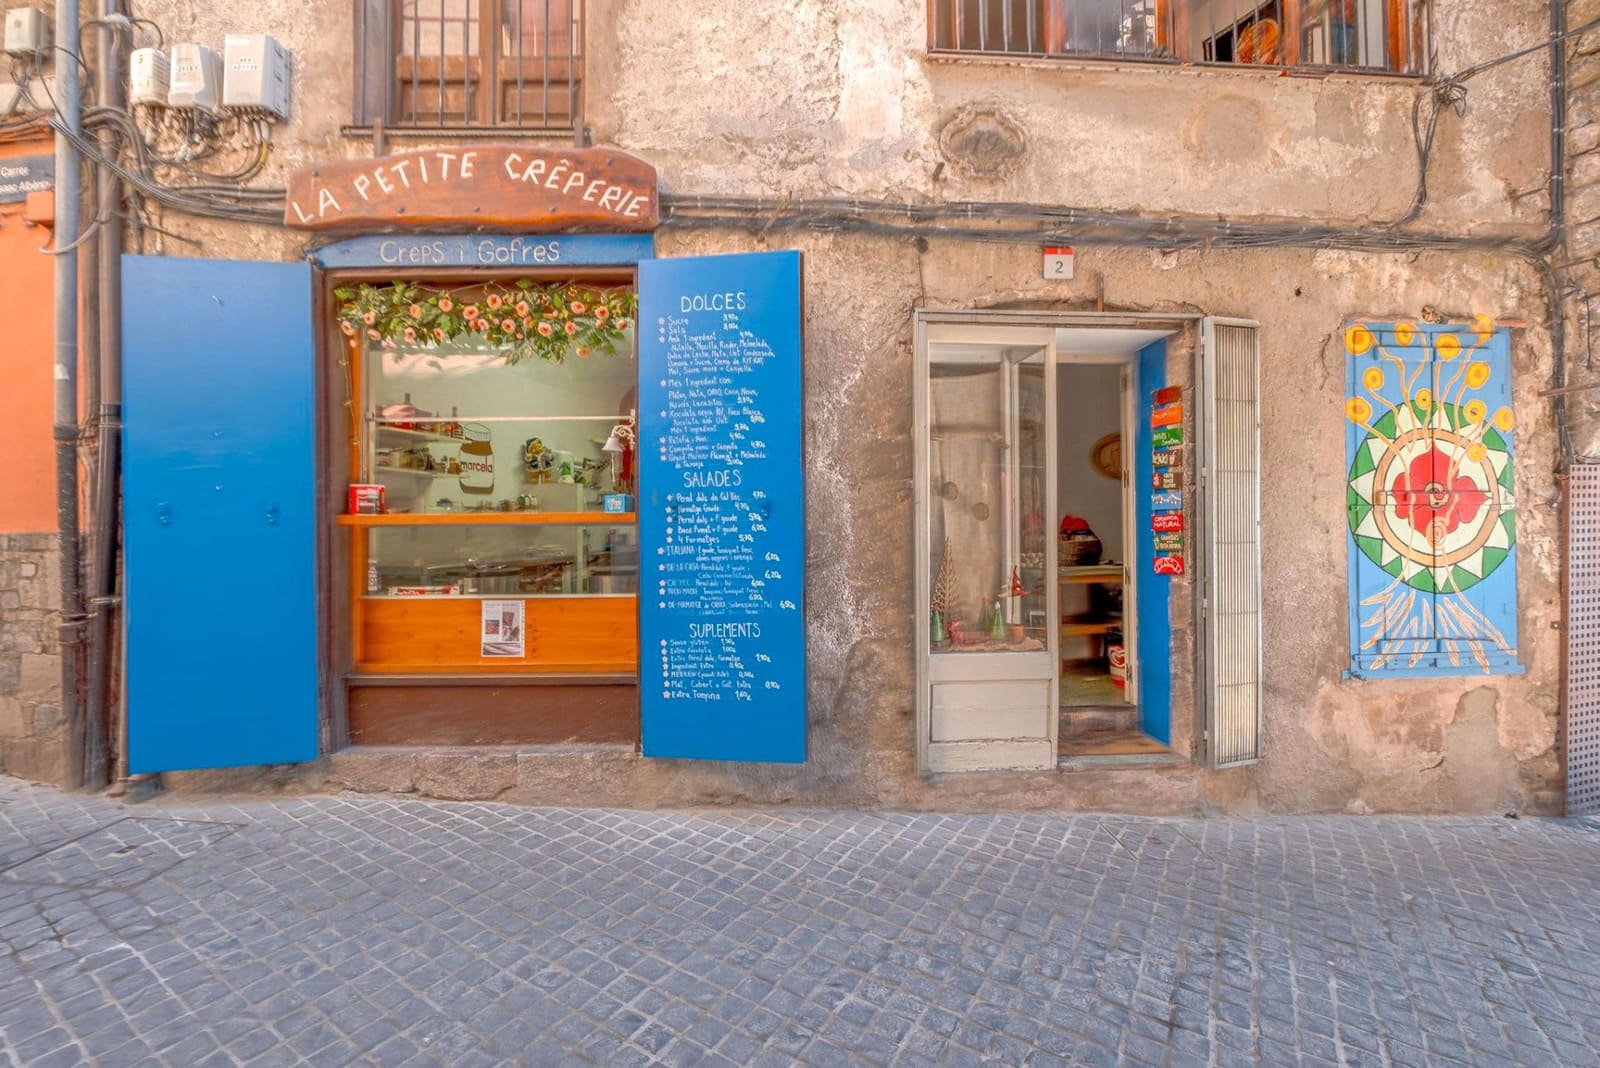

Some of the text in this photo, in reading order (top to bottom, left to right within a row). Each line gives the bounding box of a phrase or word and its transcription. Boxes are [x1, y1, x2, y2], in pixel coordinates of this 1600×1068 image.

[292, 151, 649, 225] LA PETITE CRÊPERIE
[1055, 260, 1064, 274] 2
[681, 291, 746, 313] DOLCES
[683, 469, 742, 488] SALADES
[688, 622, 761, 639] SUPLEMENTS
